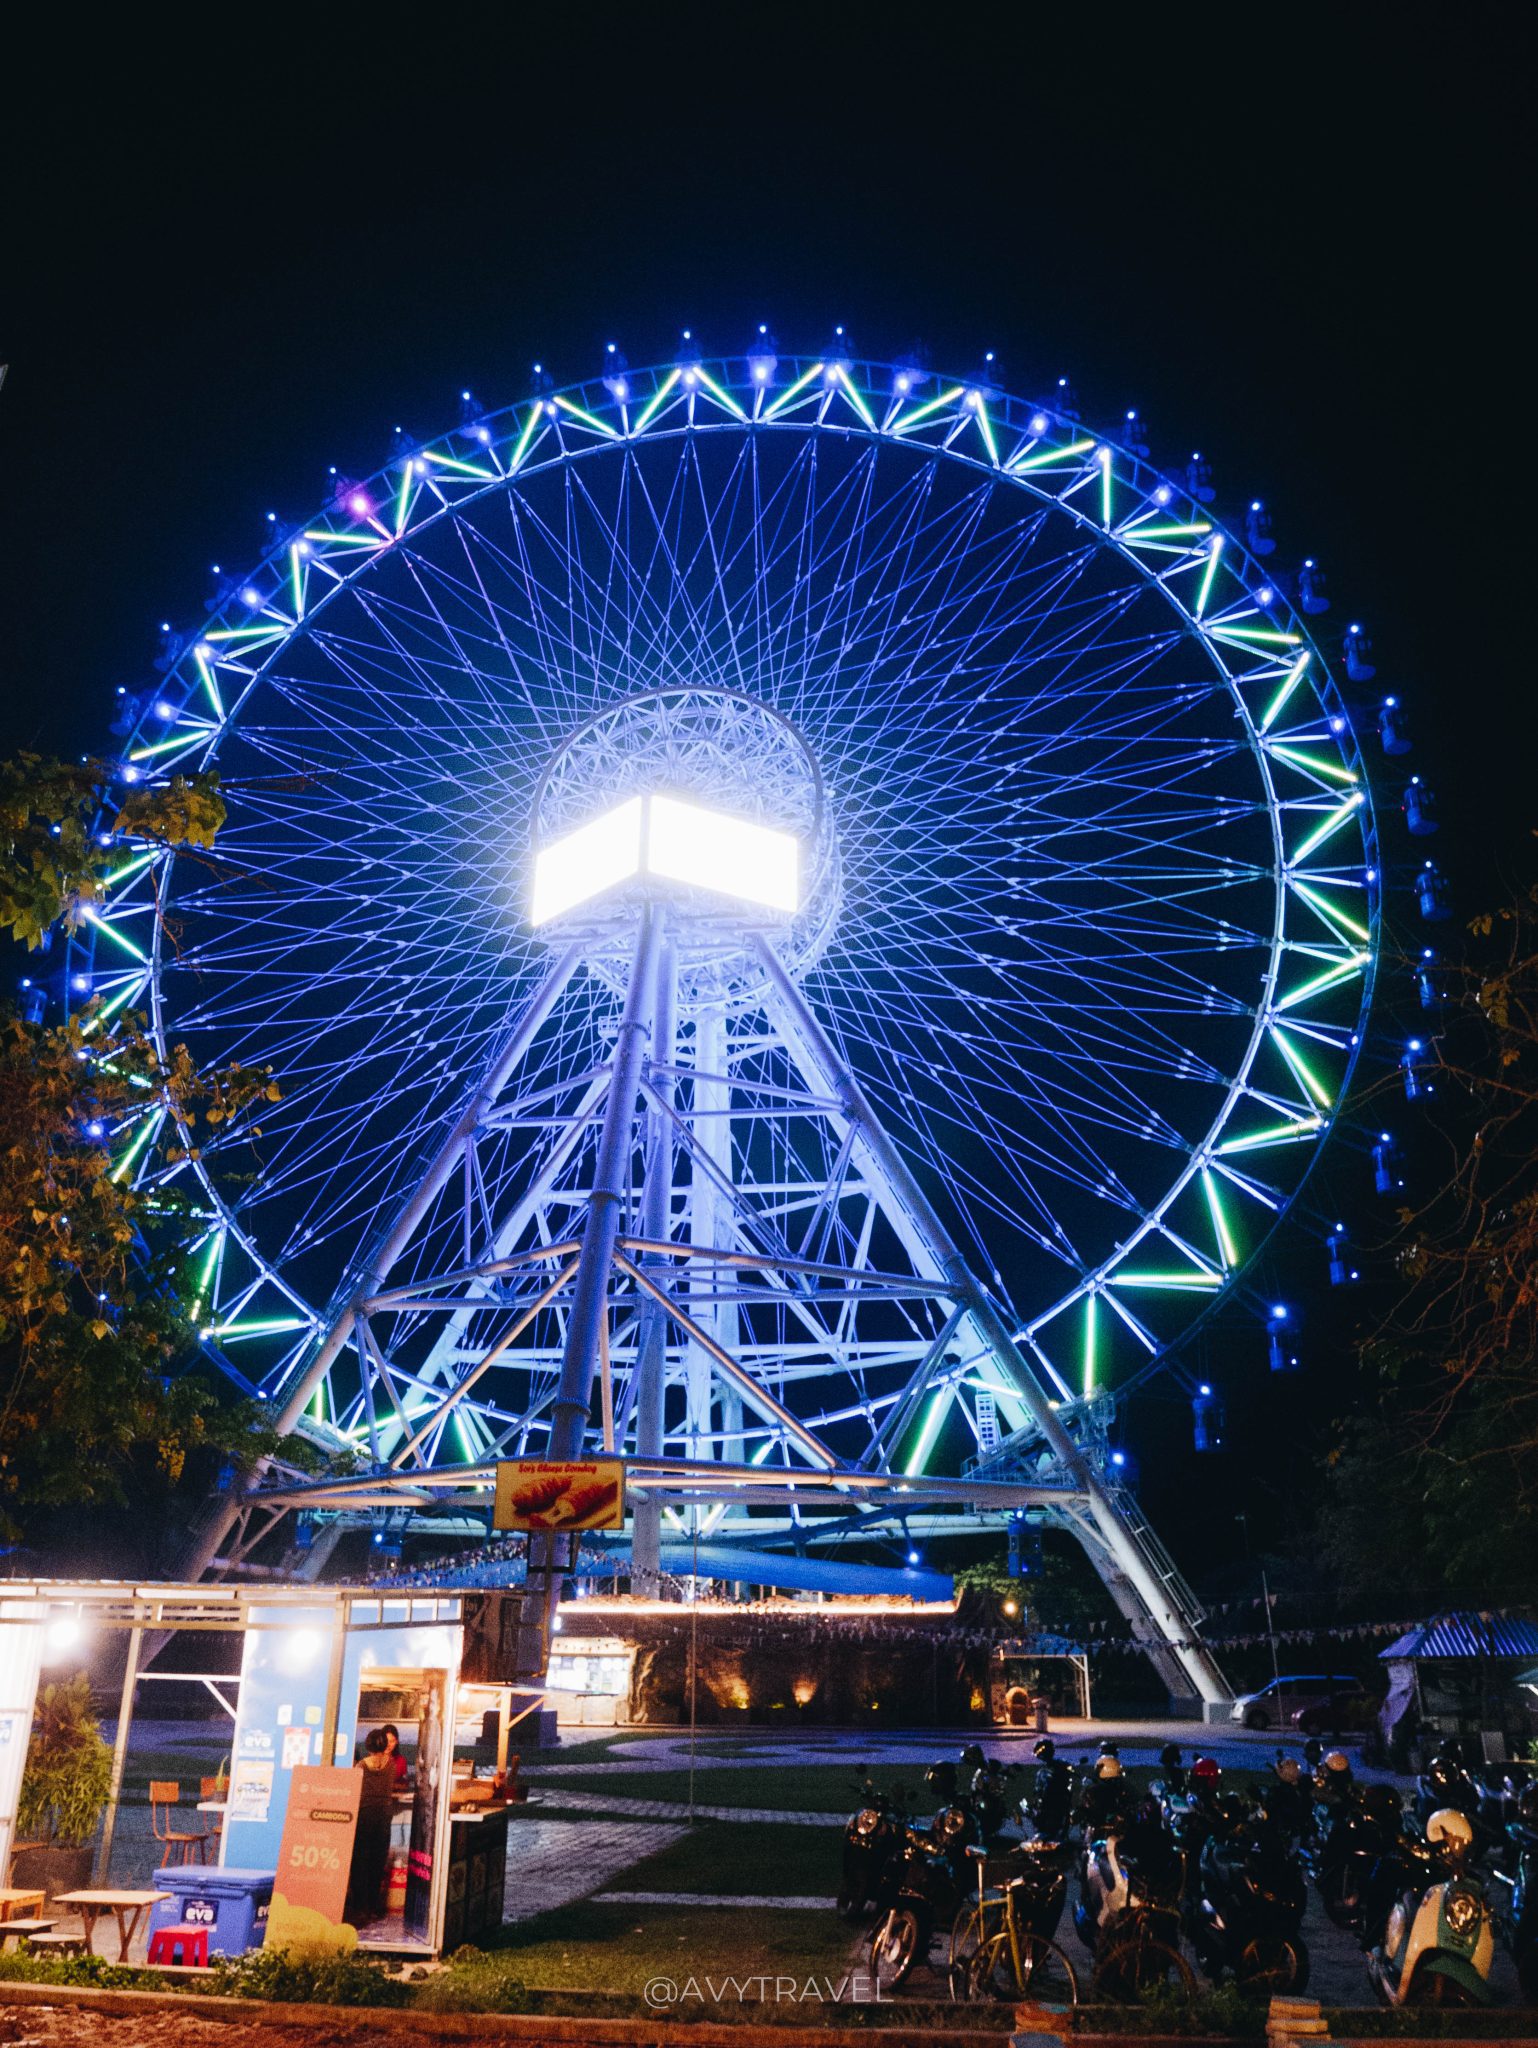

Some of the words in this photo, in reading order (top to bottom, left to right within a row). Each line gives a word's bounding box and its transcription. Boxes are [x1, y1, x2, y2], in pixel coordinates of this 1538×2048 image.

[244, 1735, 271, 1748] eva
[289, 1845, 340, 1870] 50%
[185, 1907, 214, 1921] eva
[257, 1905, 270, 1918] ev
